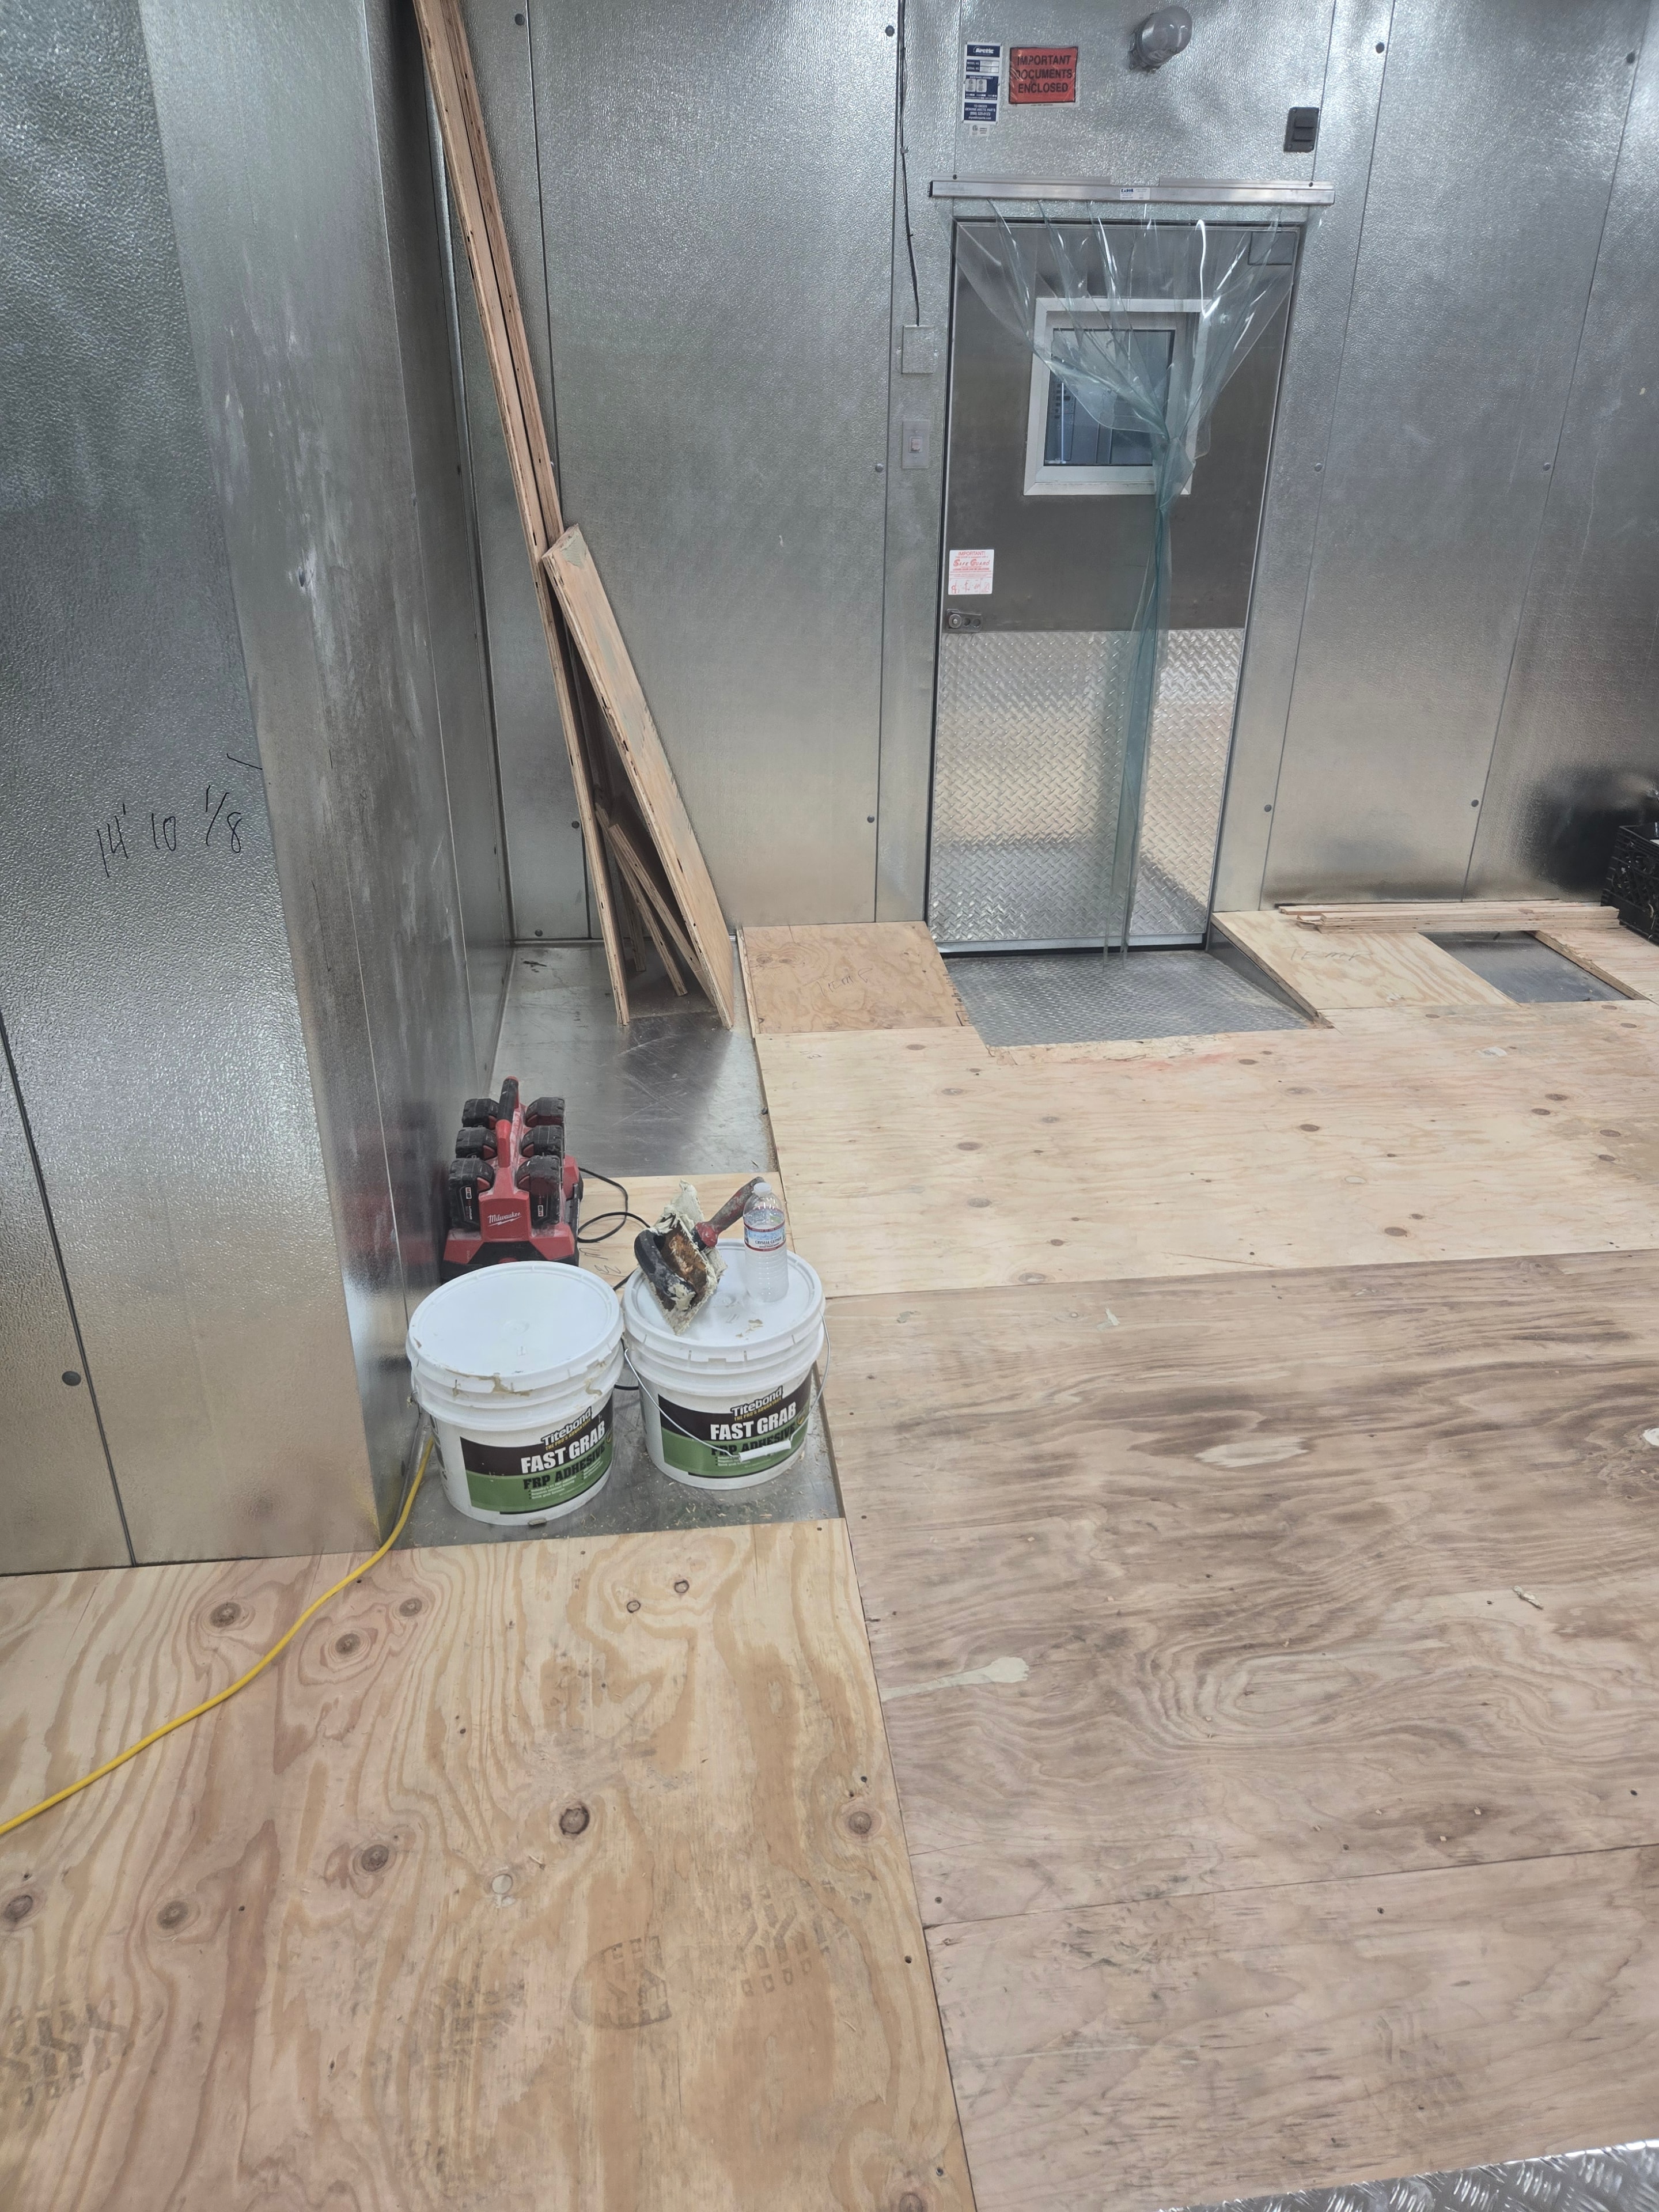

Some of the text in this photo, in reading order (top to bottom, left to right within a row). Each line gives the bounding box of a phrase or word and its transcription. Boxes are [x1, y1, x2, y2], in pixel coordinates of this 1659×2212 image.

[1014, 69, 1073, 79] DOCUMENTS
[1016, 55, 1072, 66] IMPORTANT
[1018, 83, 1069, 93] ENCLOSED
[151, 812, 177, 852] 10
[487, 1211, 522, 1224] Milwaukee
[732, 1386, 783, 1415] Titebond
[542, 1407, 593, 1446] Titebond
[710, 1402, 797, 1441] FAST GRAB
[521, 1446, 566, 1474] FAST
[569, 1420, 605, 1460] GRAB
[546, 1443, 555, 1451] THE
[523, 1474, 551, 1490] FRP
[555, 1441, 606, 1483] ADHESIVE
